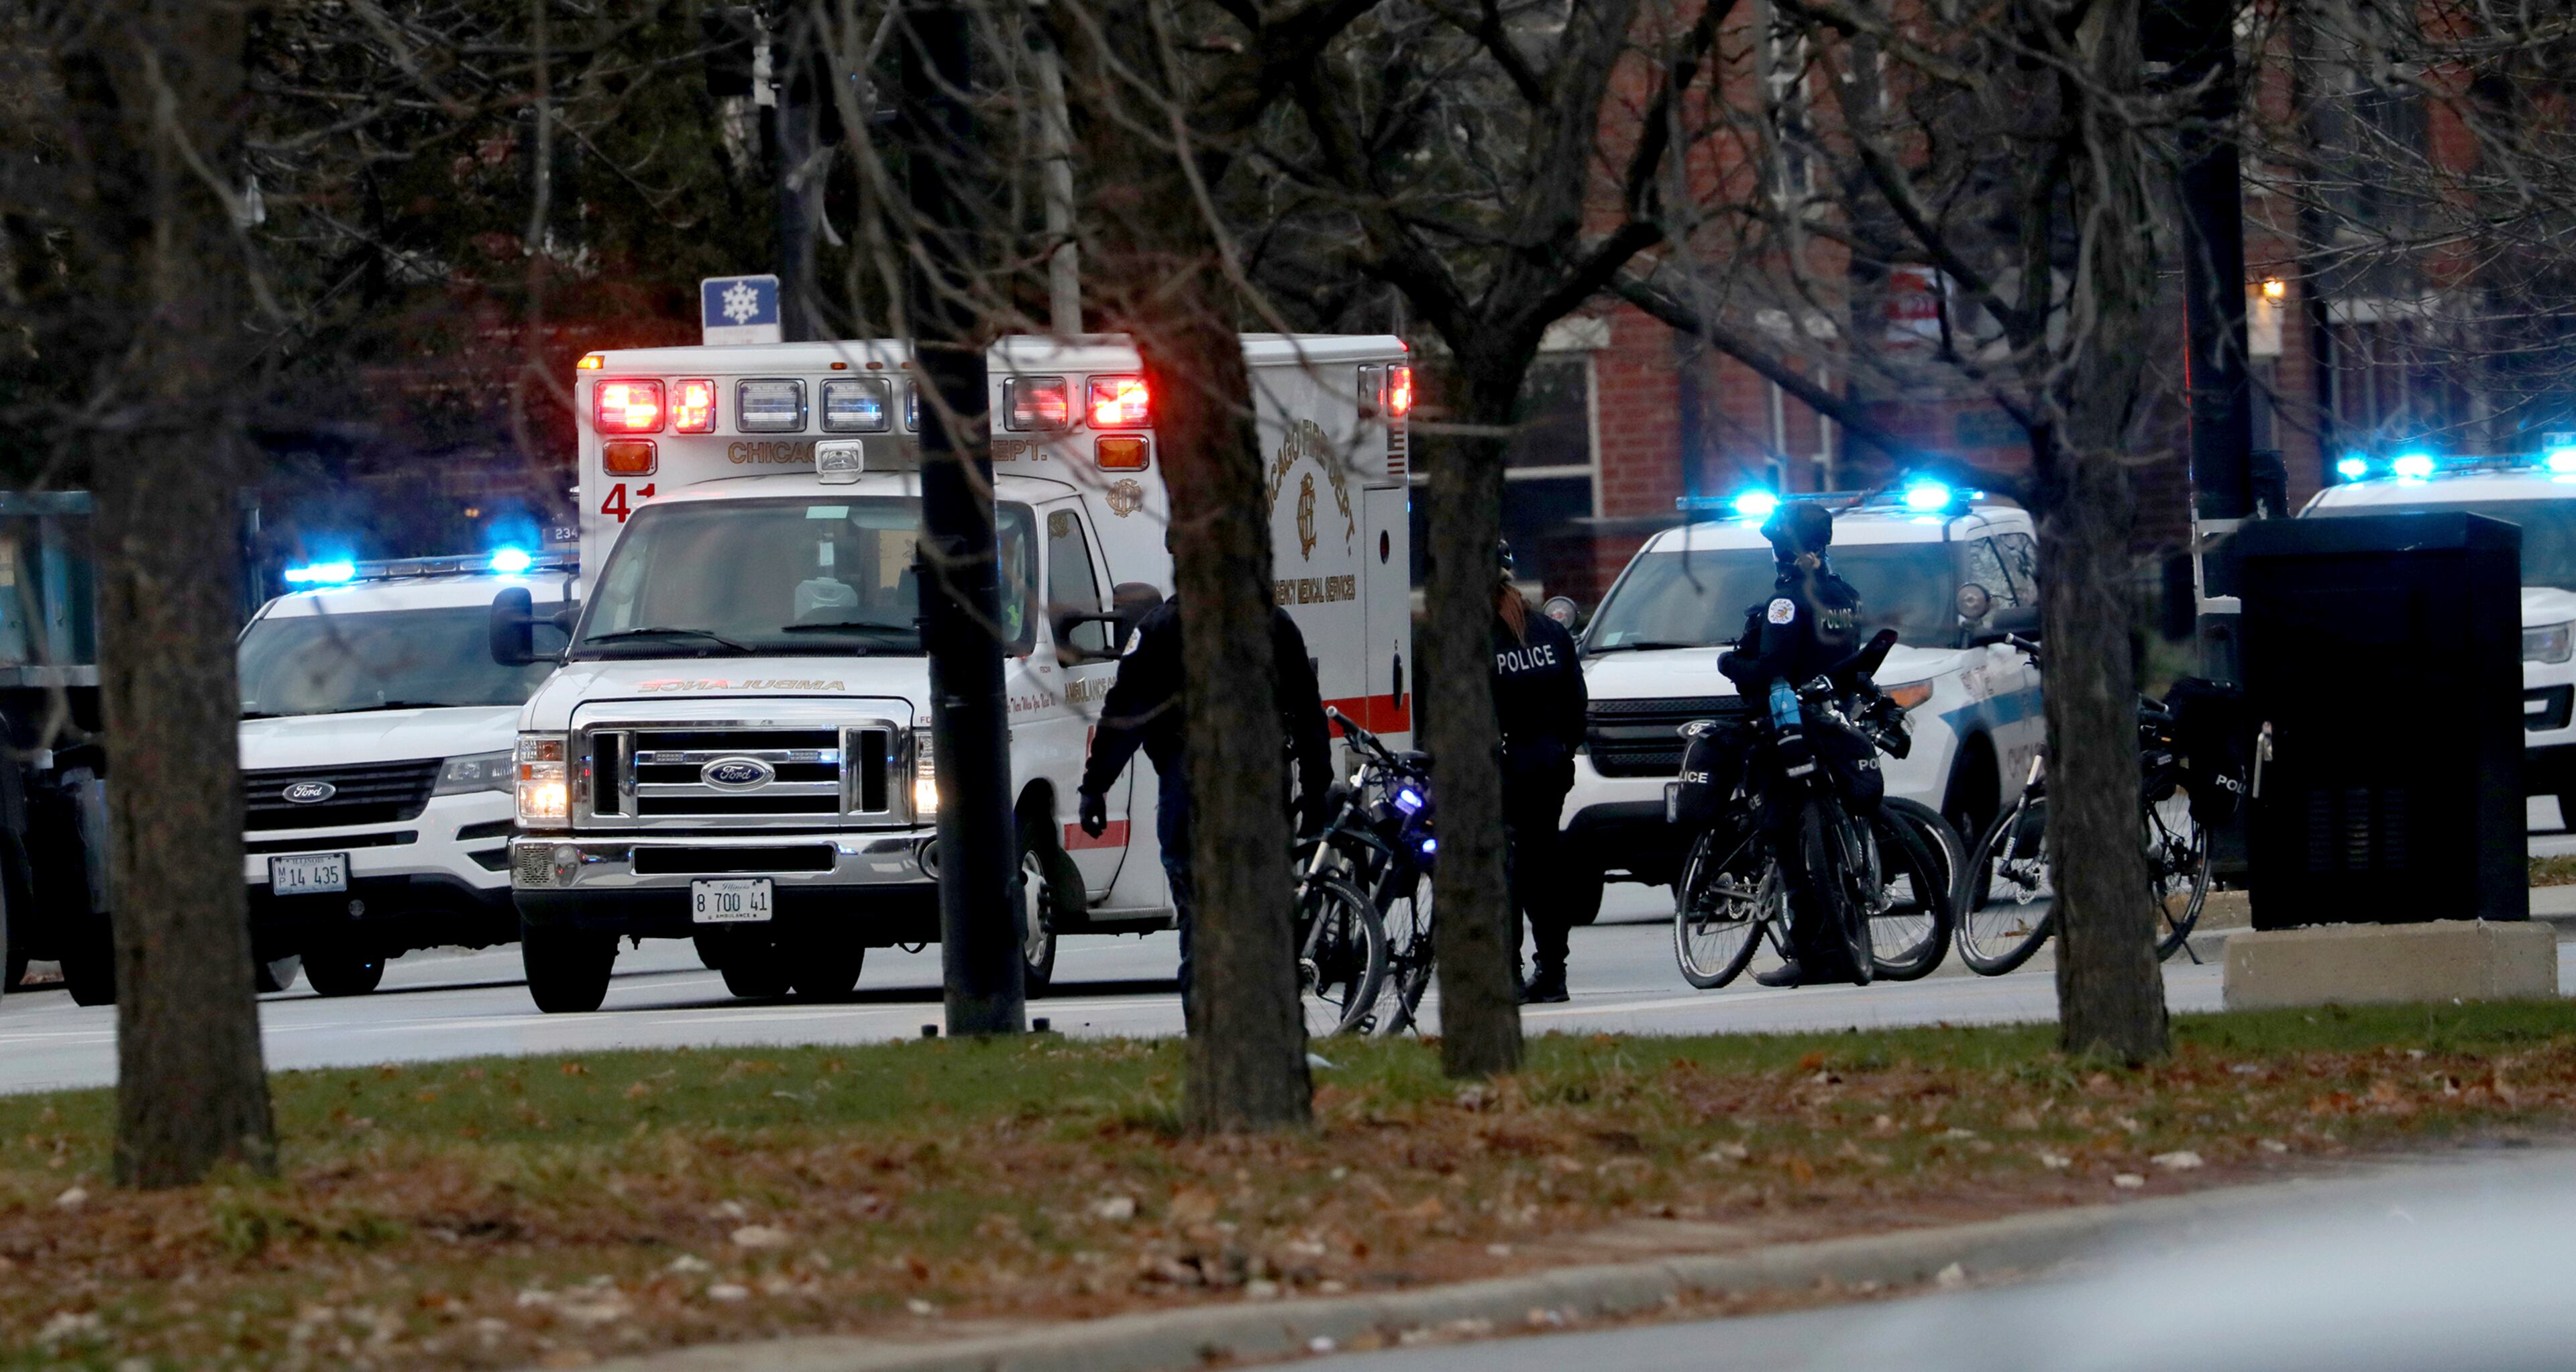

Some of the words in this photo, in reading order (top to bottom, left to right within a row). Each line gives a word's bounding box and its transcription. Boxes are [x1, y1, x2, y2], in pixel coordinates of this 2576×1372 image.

[728, 441, 816, 464] CHICA
[991, 439, 1047, 462] EPT.
[1265, 422, 1300, 521] ICAGO
[1297, 577, 1324, 604] MEDICAL
[1325, 574, 1356, 602] SERVICES
[1496, 644, 1556, 675] POLICE
[720, 765, 752, 780] Ford
[293, 784, 323, 798] Ford
[290, 868, 305, 887] 14
[314, 865, 339, 884] 435
[722, 883, 751, 891] Illinois
[697, 894, 706, 912] 8
[714, 892, 740, 912] 700
[751, 892, 767, 911] 41
